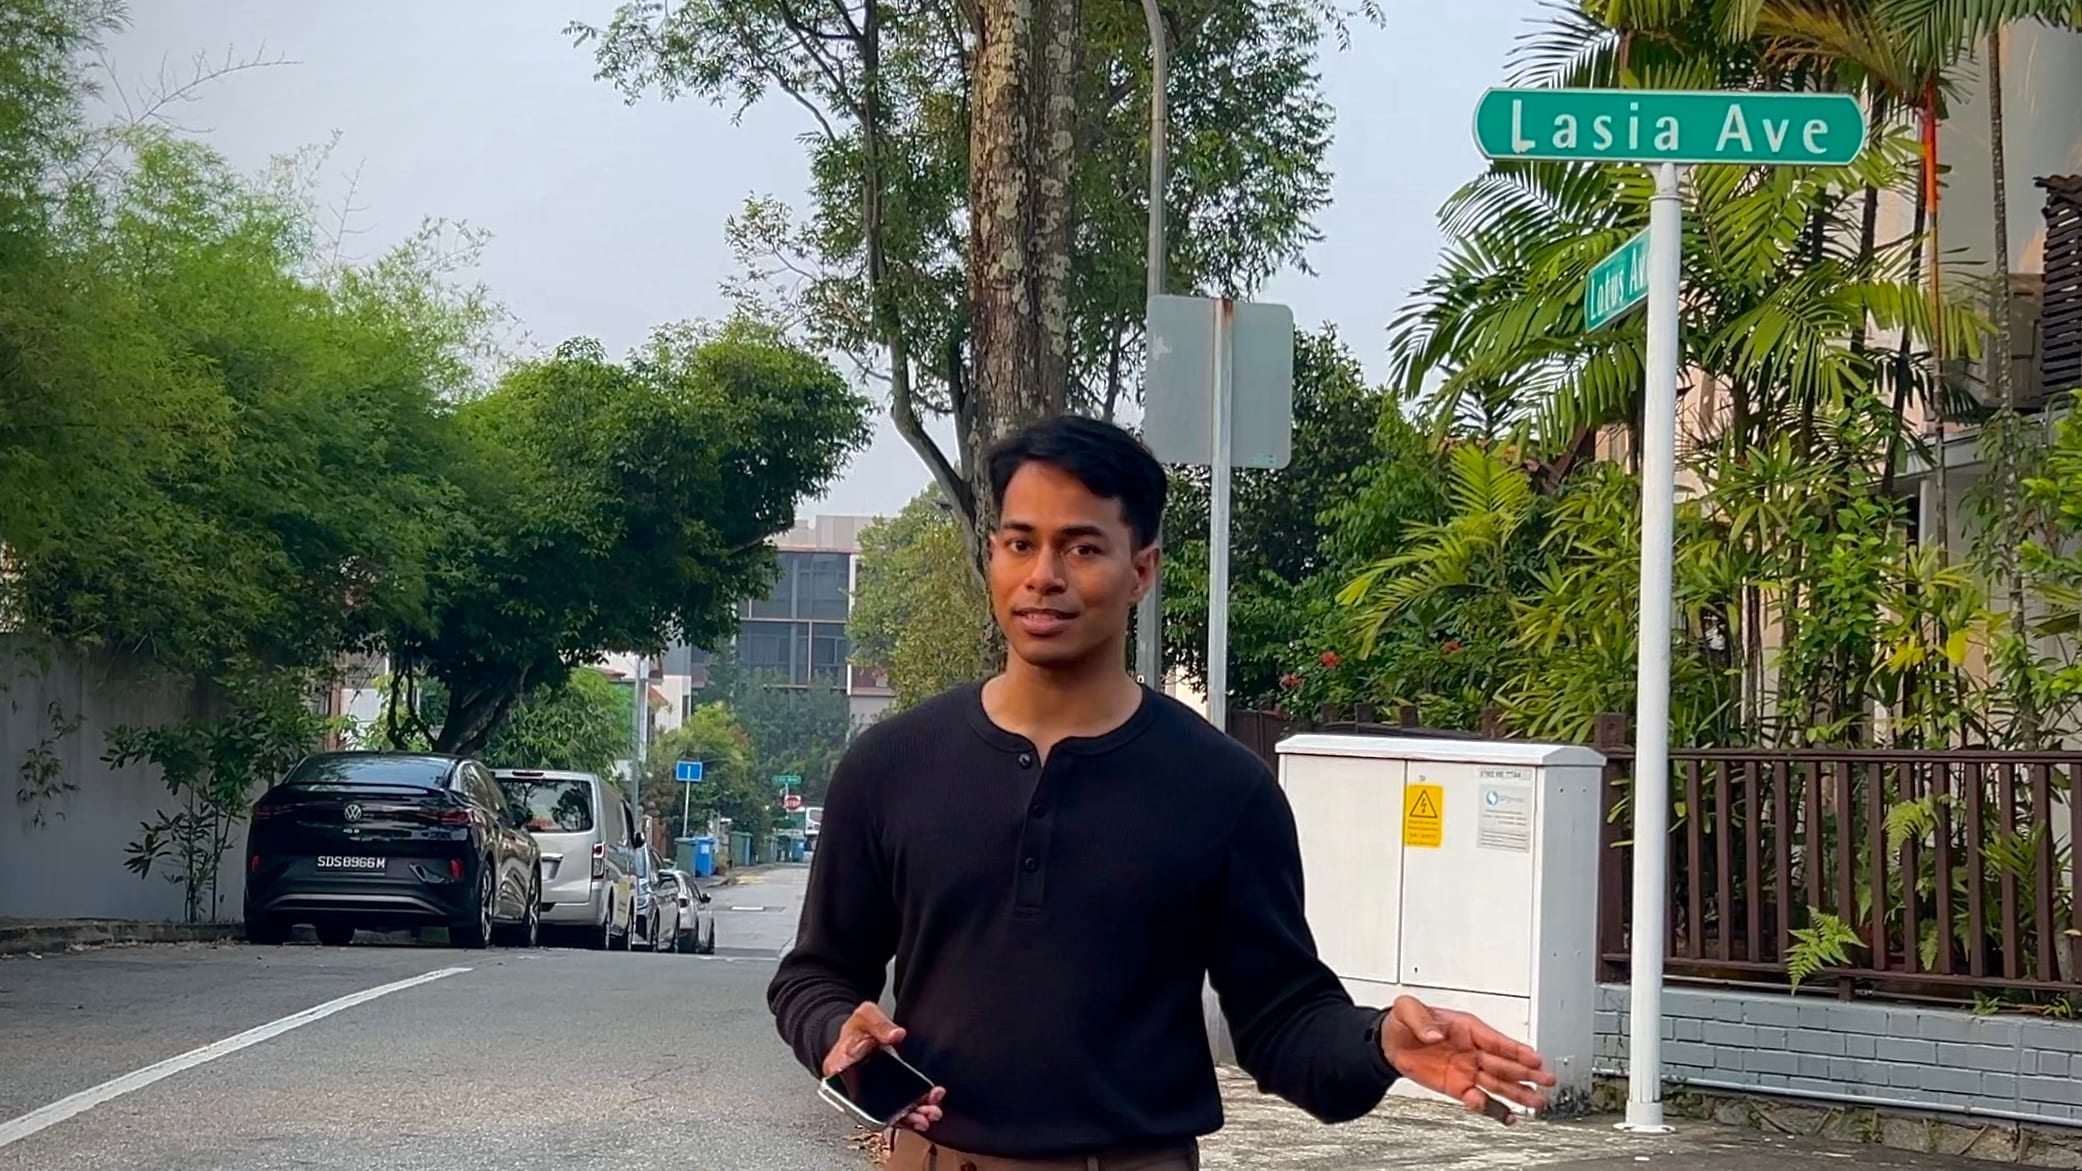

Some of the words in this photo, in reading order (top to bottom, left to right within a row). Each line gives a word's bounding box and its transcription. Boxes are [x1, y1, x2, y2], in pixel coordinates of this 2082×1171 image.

[1512, 99, 1679, 153] Lasia
[1716, 104, 1829, 154] Ave
[1591, 269, 1624, 320] Lotus
[1629, 247, 1647, 296] Av
